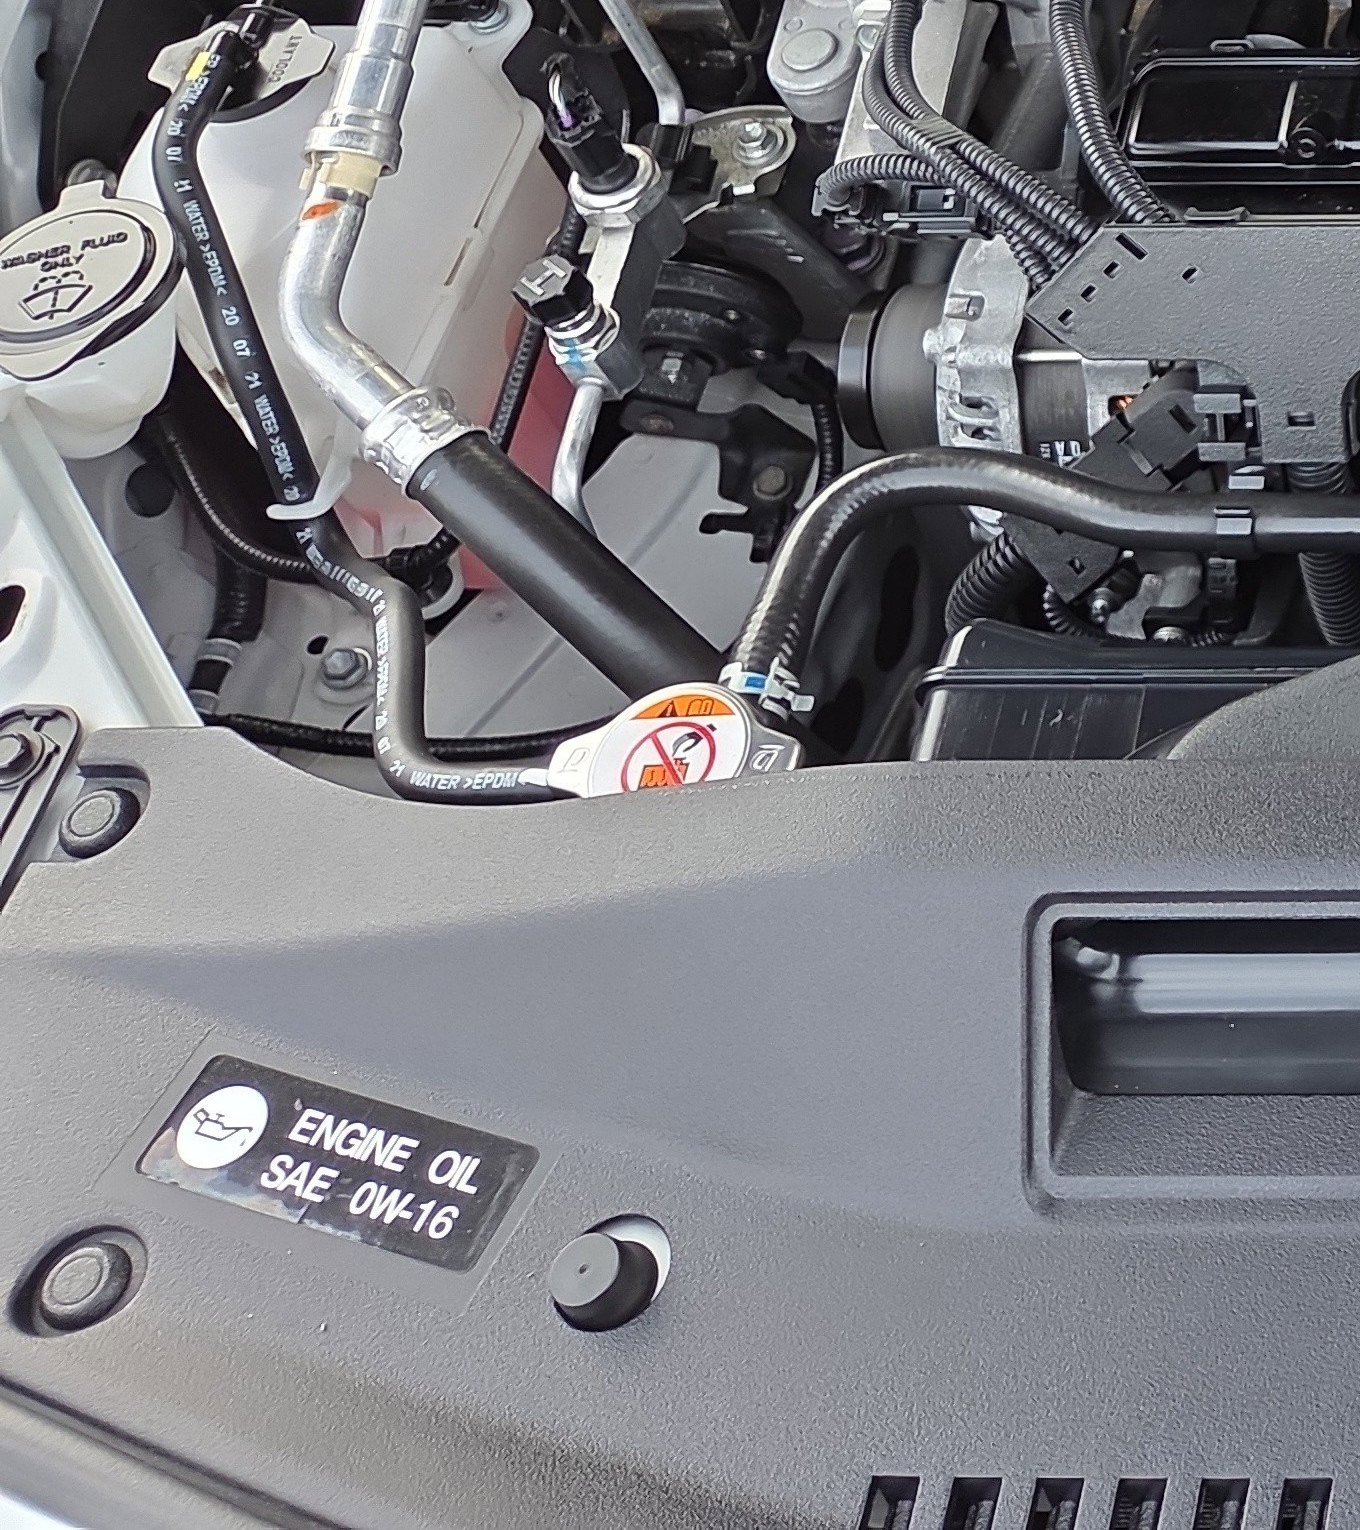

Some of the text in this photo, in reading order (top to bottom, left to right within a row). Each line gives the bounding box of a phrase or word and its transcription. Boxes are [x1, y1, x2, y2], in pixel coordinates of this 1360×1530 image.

[268, 35, 302, 84] COOLANT
[40, 254, 84, 272] ONLY
[81, 232, 128, 251] FLUID
[182, 199, 211, 242] WATER
[221, 306, 240, 327] 20
[232, 339, 251, 358] 07
[254, 393, 280, 436] WATER
[409, 770, 461, 790] WATER
[462, 772, 525, 790] >EPDM
[288, 1109, 481, 1195] ENGINE OIL
[260, 1153, 460, 1240] SAE 0W-16
